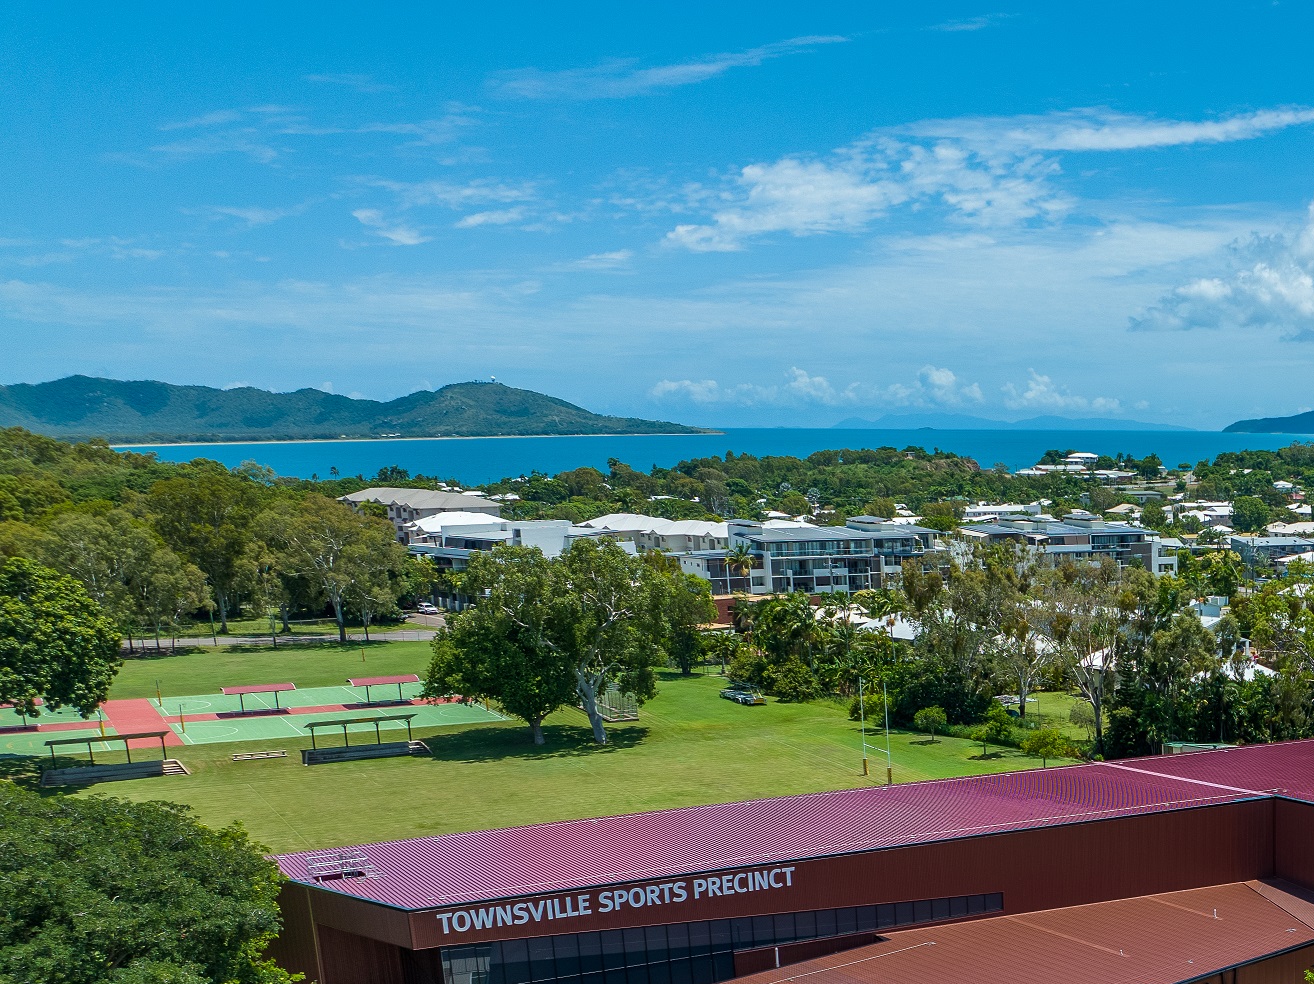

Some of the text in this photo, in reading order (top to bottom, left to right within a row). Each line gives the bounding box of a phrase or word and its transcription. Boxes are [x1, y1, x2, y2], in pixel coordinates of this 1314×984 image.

[436, 866, 796, 934] TOWNSVILLE SPORTS PRECINCT
